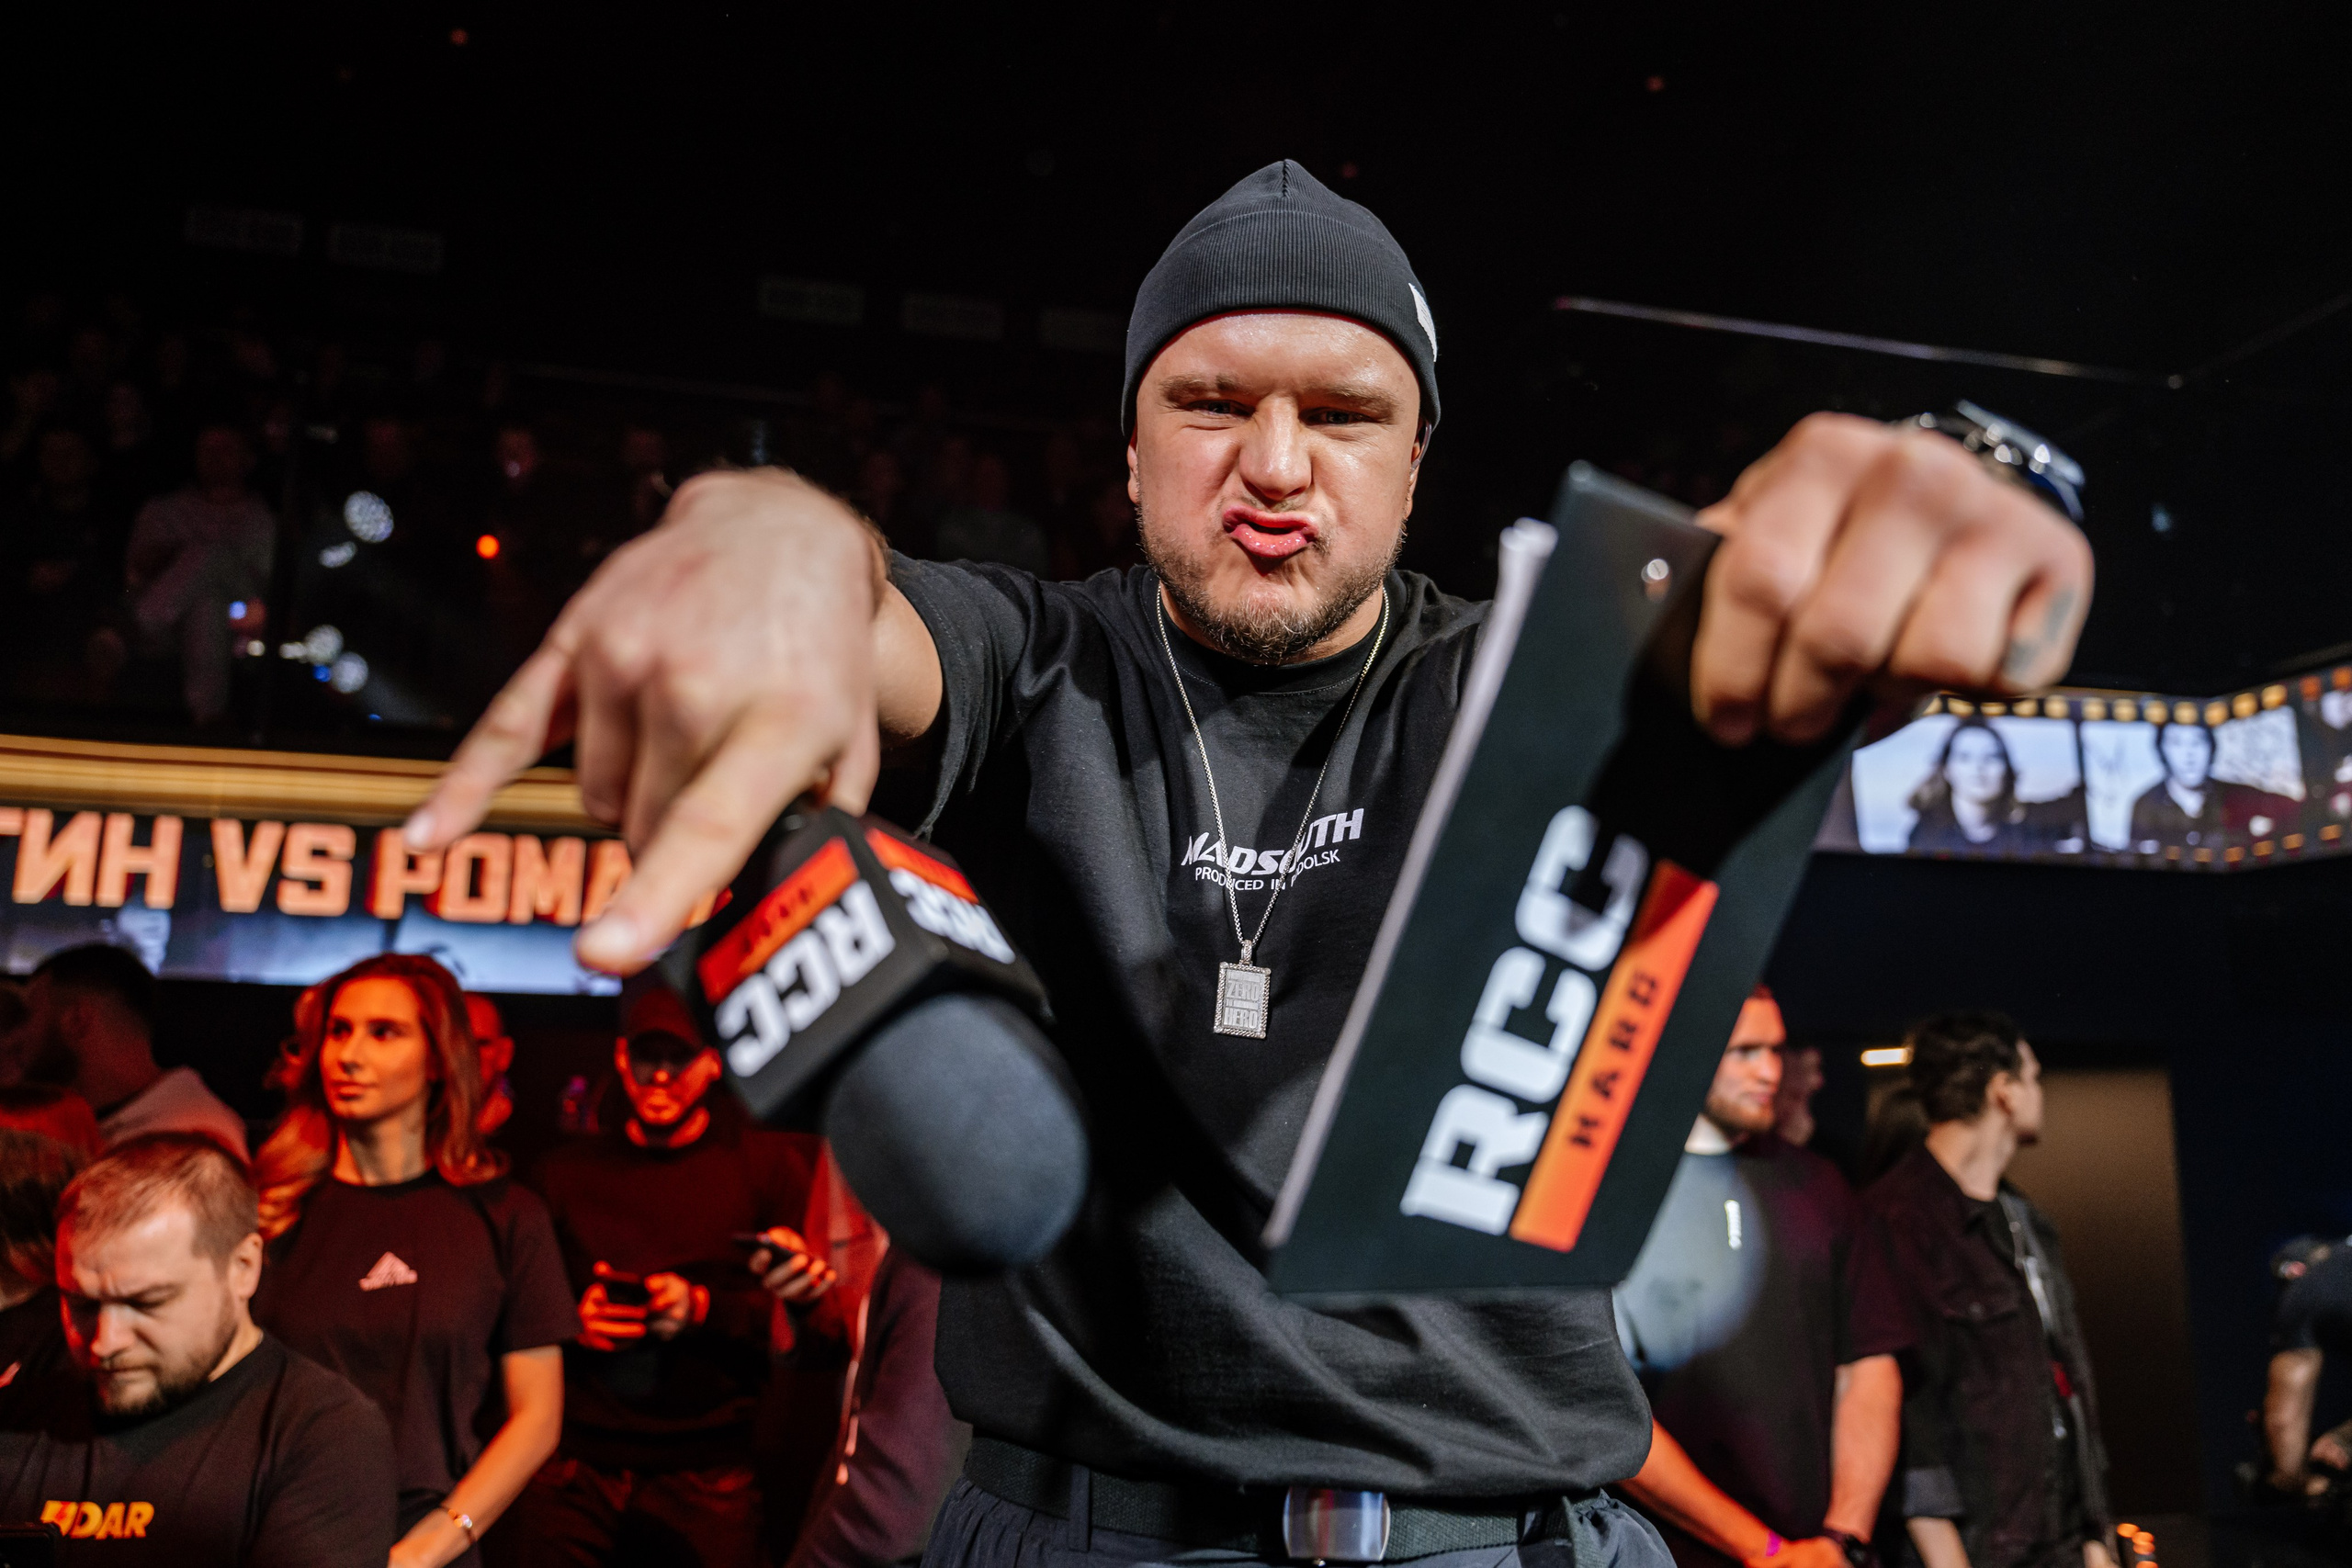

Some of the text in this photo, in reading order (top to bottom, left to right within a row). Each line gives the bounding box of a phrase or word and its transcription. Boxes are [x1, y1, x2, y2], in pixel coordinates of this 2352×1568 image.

[210, 818, 356, 917] VS
[1182, 807, 1364, 875] MADSOUTH
[714, 878, 897, 1078] RCC
[1223, 1007, 1259, 1029] HERO
[1400, 805, 1650, 1235] RCC
[1569, 969, 1658, 1147] HARD
